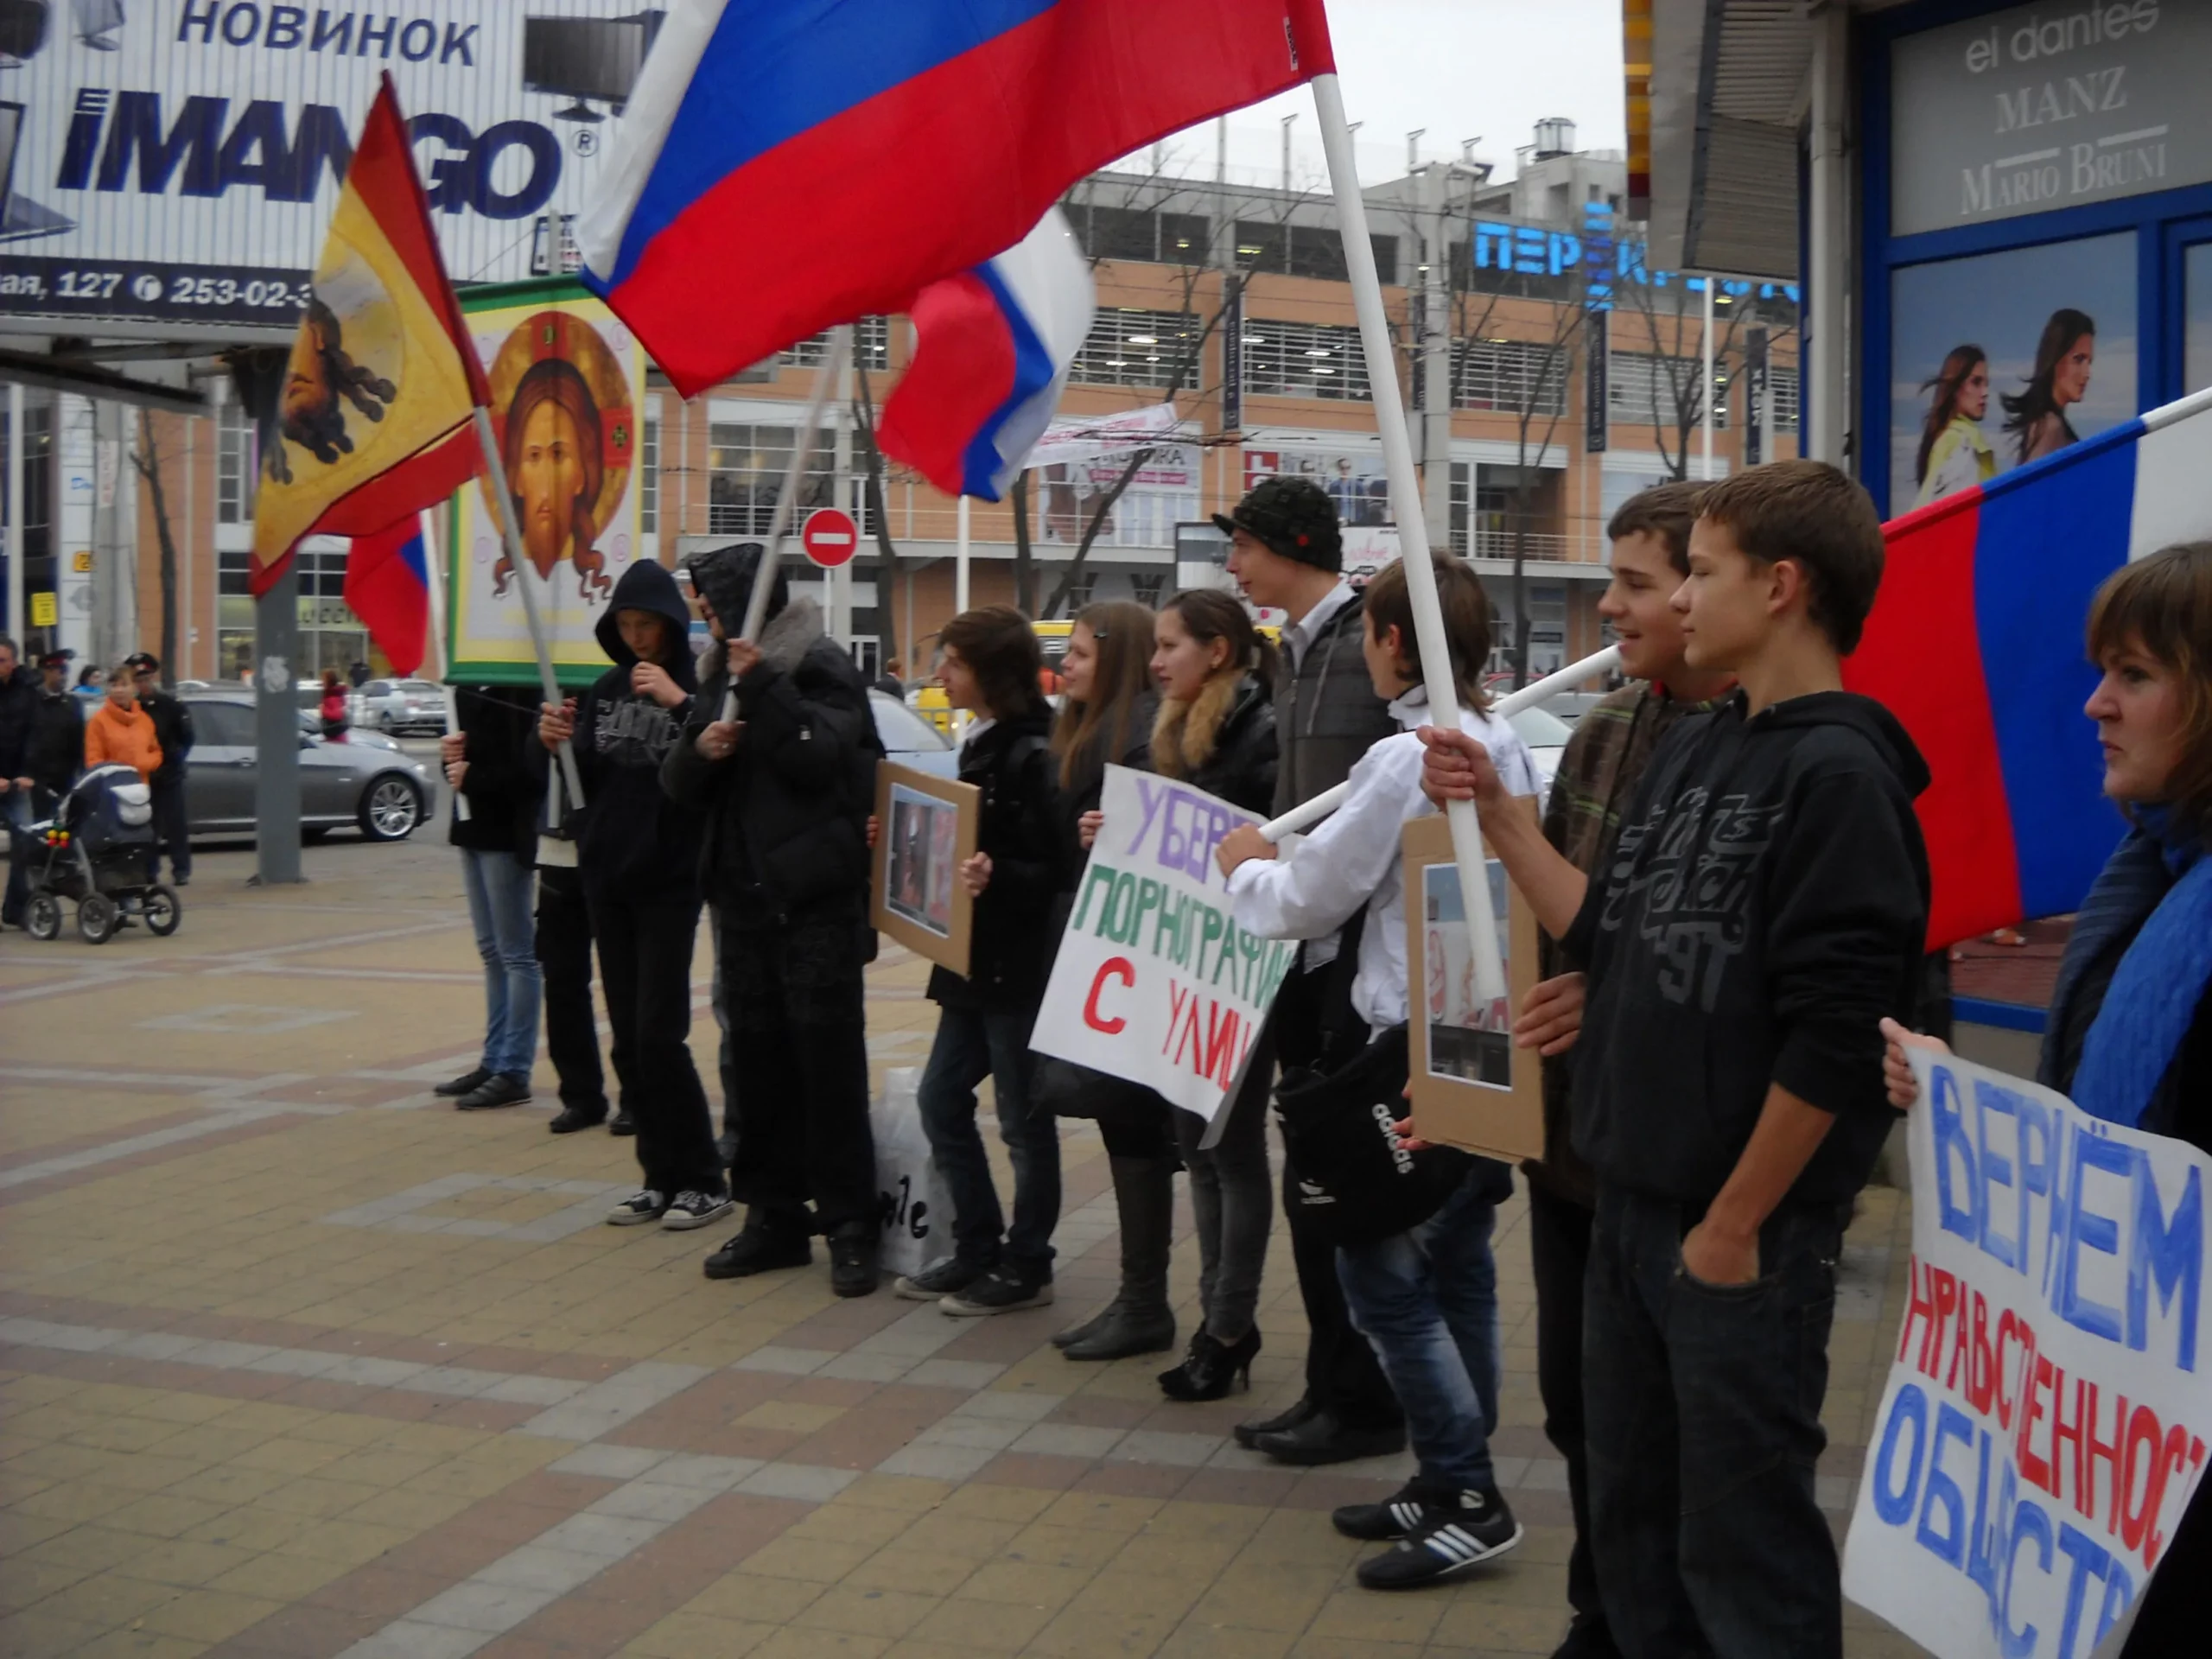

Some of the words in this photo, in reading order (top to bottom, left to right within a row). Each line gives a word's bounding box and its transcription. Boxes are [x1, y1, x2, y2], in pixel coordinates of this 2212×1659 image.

[177, 0, 480, 67] НОВИНОК
[2010, 0, 2160, 62] dantes
[1994, 66, 2128, 134] MANZ
[0, 272, 48, 300] ая,
[56, 271, 123, 298] 127
[1127, 779, 1262, 893] УБЕР
[1083, 957, 1135, 1035] С
[1929, 1065, 2202, 1373] ВЕРНЁМ
